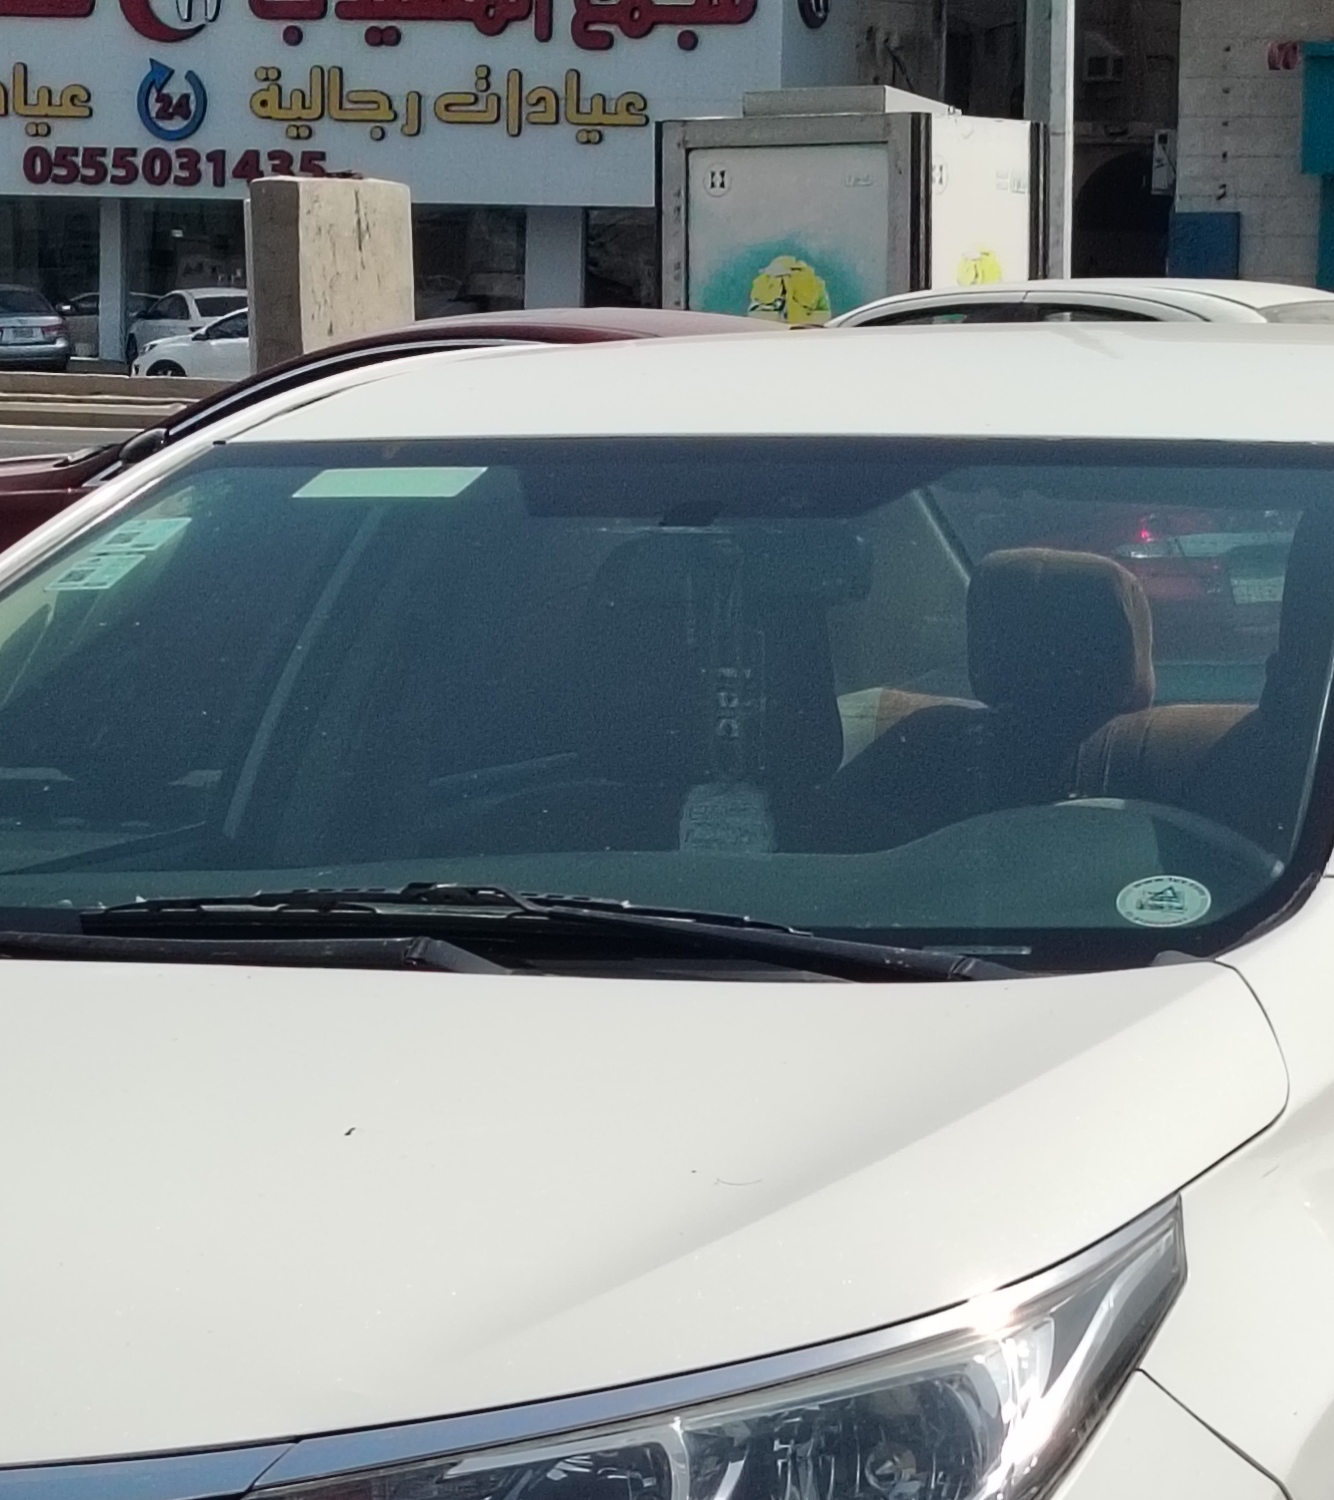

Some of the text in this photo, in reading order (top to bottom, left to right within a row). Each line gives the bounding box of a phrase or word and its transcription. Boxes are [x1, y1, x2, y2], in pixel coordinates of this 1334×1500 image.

[154, 92, 193, 122] 24
[249, 64, 650, 145] عيادات رجالية
[22, 145, 327, 188] 0555031435
